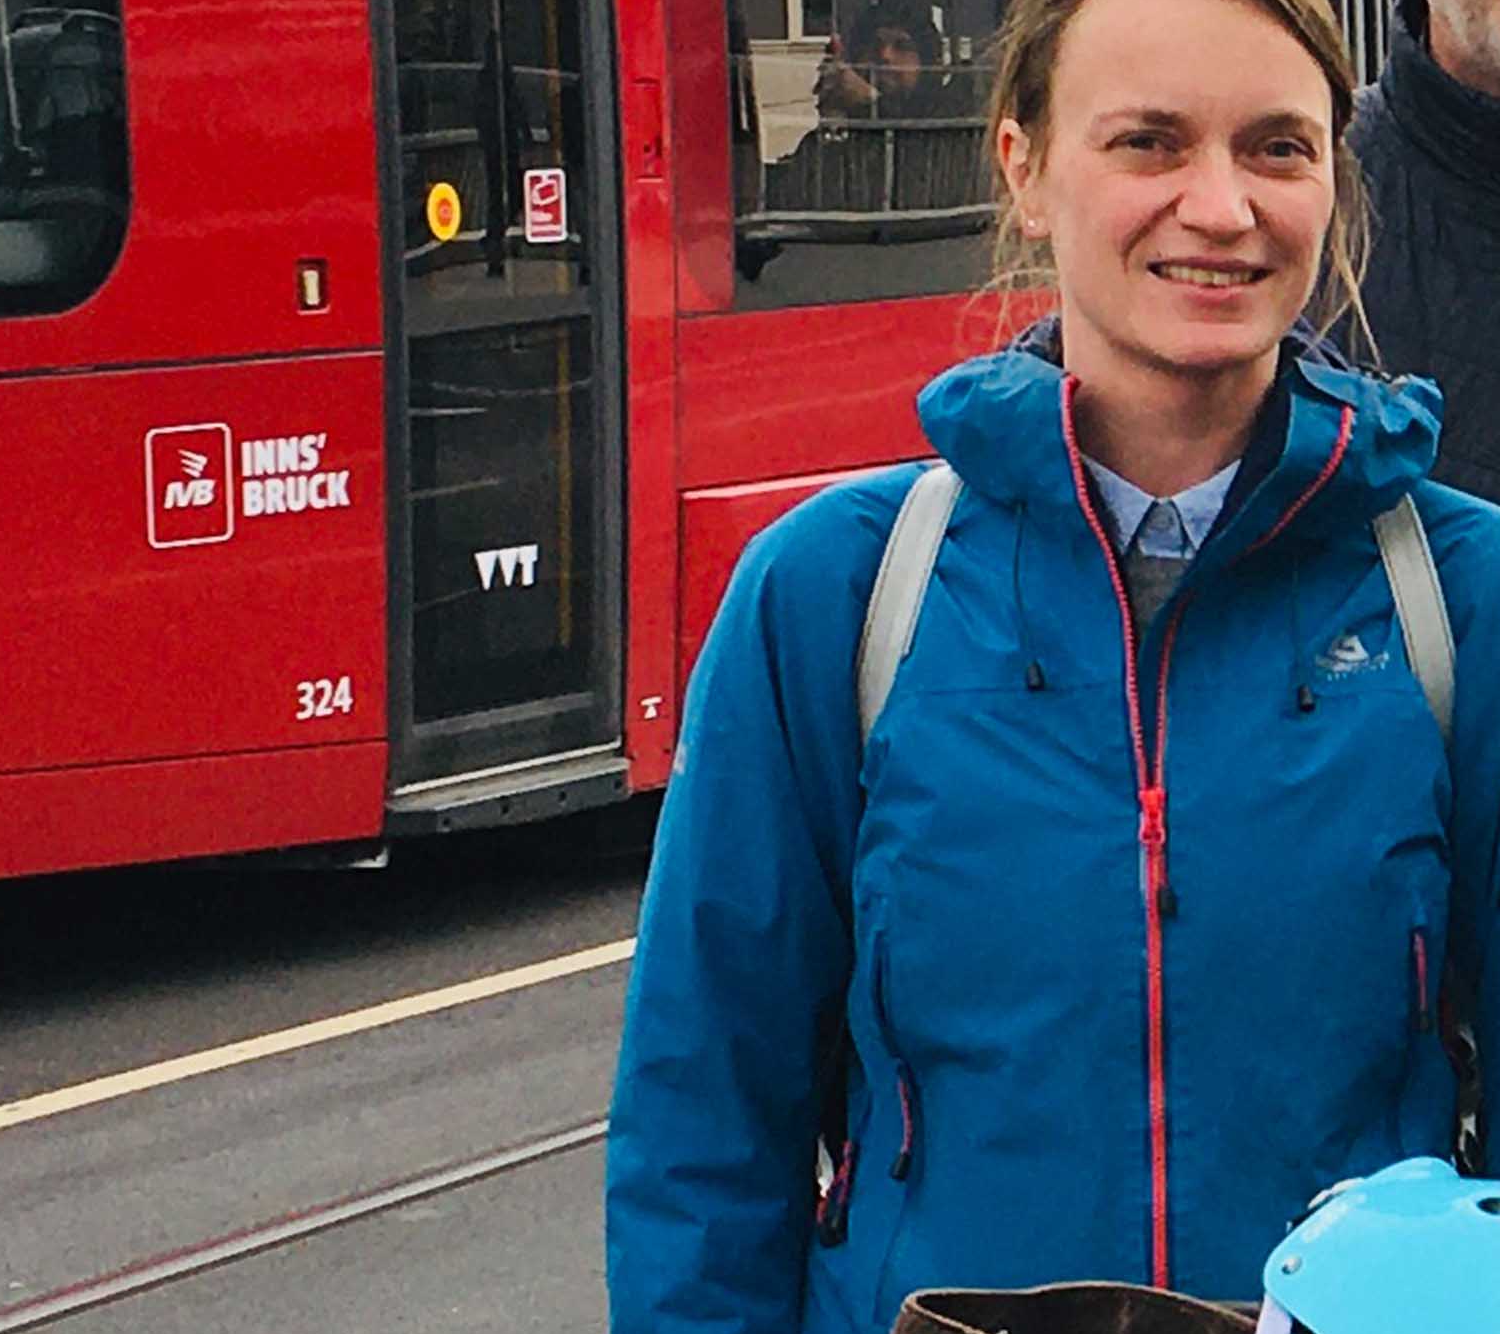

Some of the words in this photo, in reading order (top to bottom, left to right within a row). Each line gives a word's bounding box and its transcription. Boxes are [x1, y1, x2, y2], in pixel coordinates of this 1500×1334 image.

[164, 479, 216, 509] IVB
[242, 470, 350, 517] BRUCK
[473, 544, 538, 591] VVT
[295, 675, 354, 720] 324
